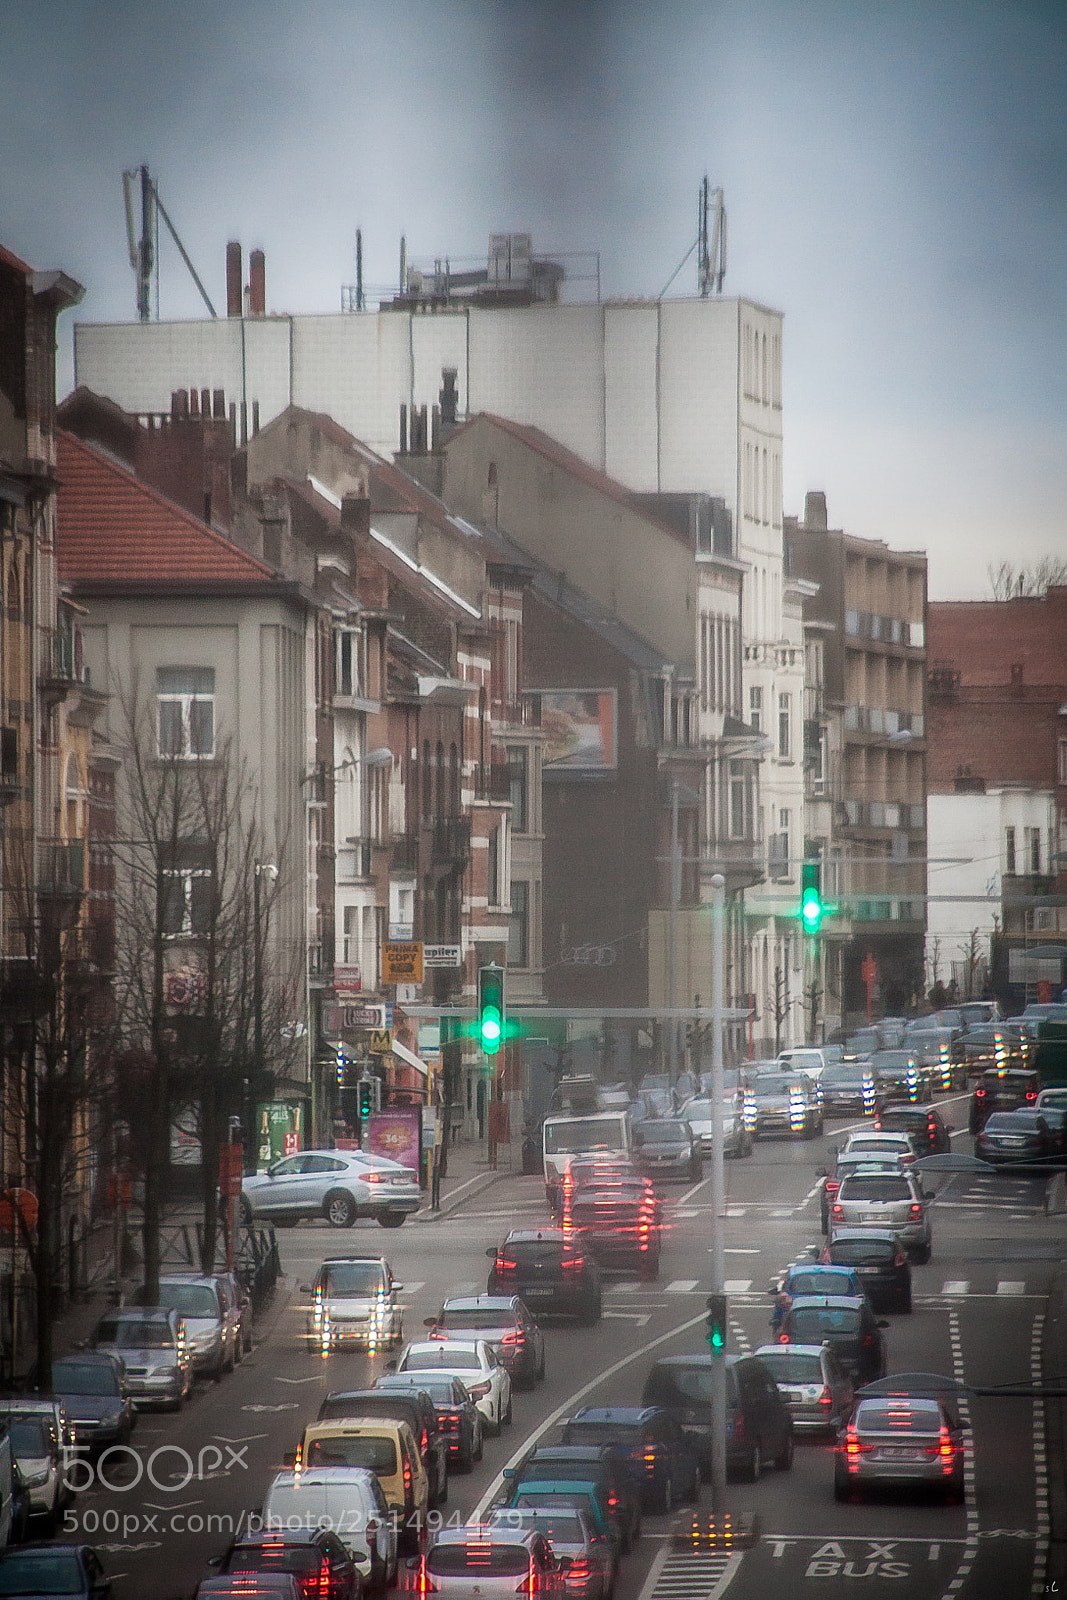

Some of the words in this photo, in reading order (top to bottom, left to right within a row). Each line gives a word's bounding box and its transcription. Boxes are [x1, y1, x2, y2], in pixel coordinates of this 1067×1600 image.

[388, 954, 417, 962] COPY
[373, 1030, 390, 1043] M
[766, 1541, 940, 1561] TAXI
[804, 1561, 913, 1577] BUS
